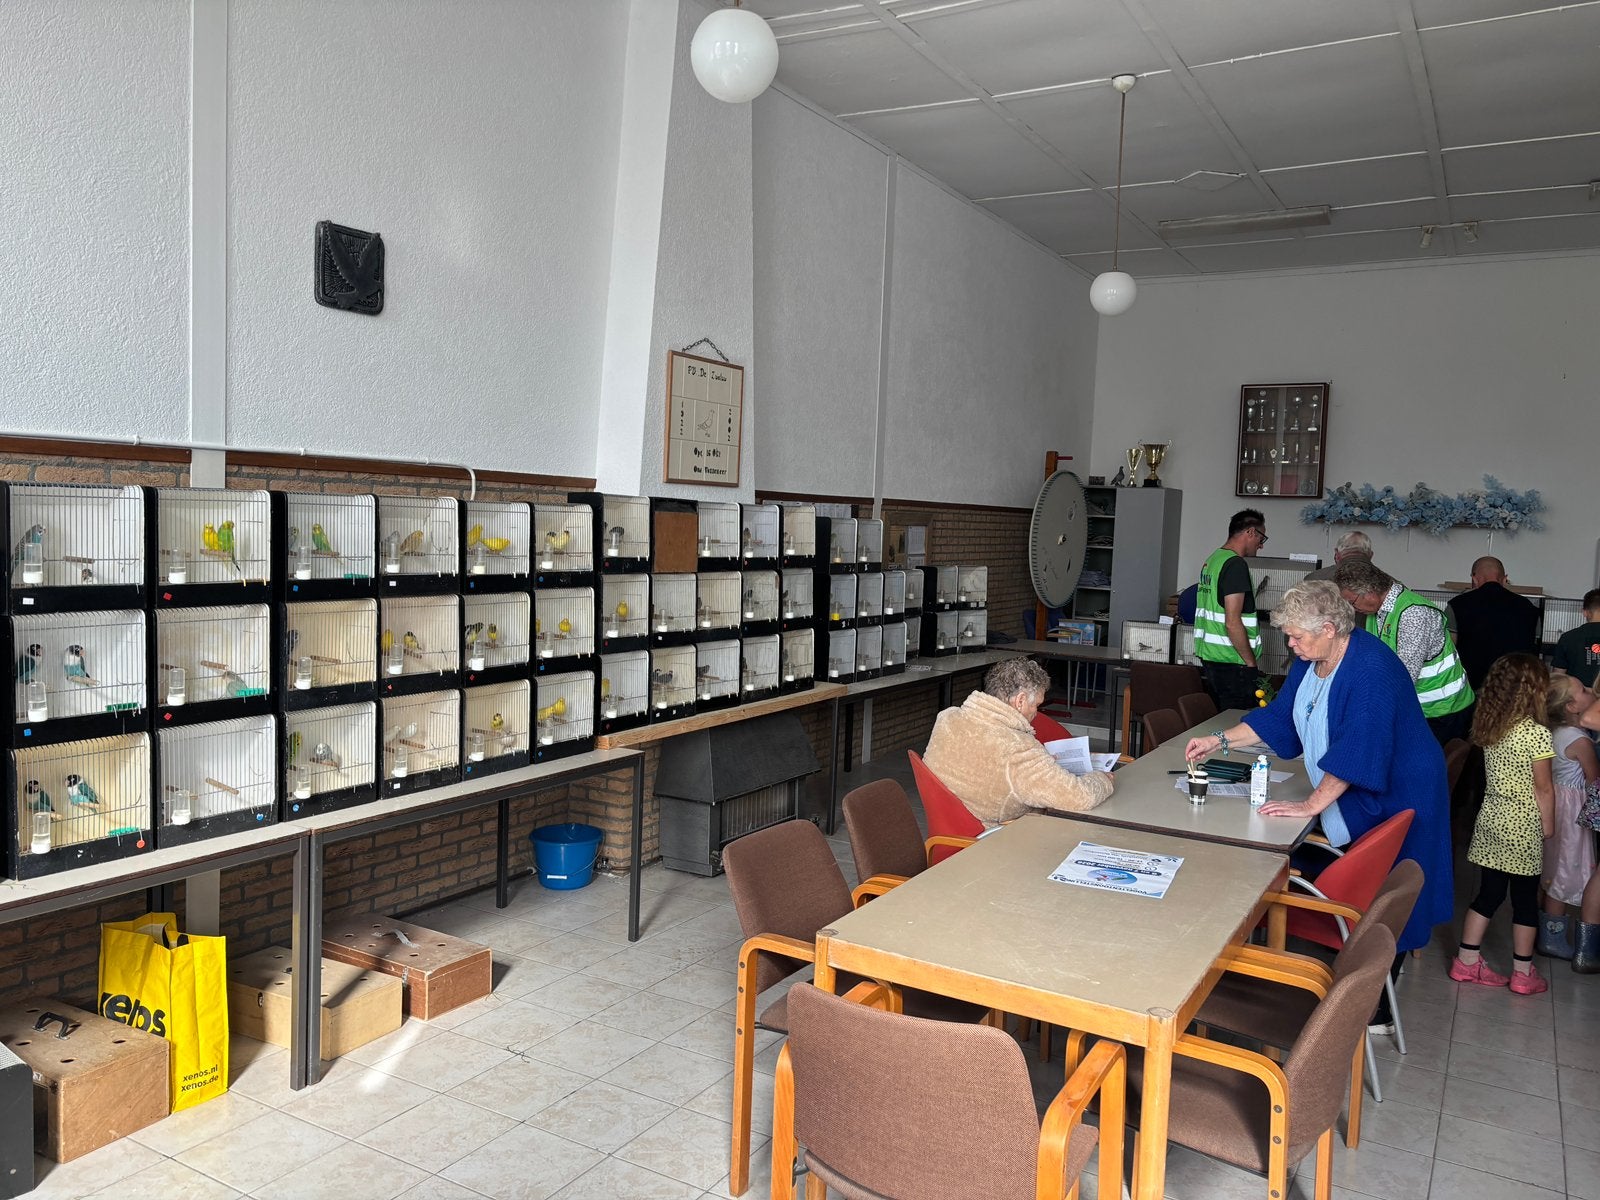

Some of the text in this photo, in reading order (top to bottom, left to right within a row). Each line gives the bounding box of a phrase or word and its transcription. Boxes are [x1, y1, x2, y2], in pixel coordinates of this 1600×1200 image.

[700, 367, 707, 378] De
[183, 1064, 218, 1082] xenos.nl
[181, 1075, 219, 1092] xenos.de
